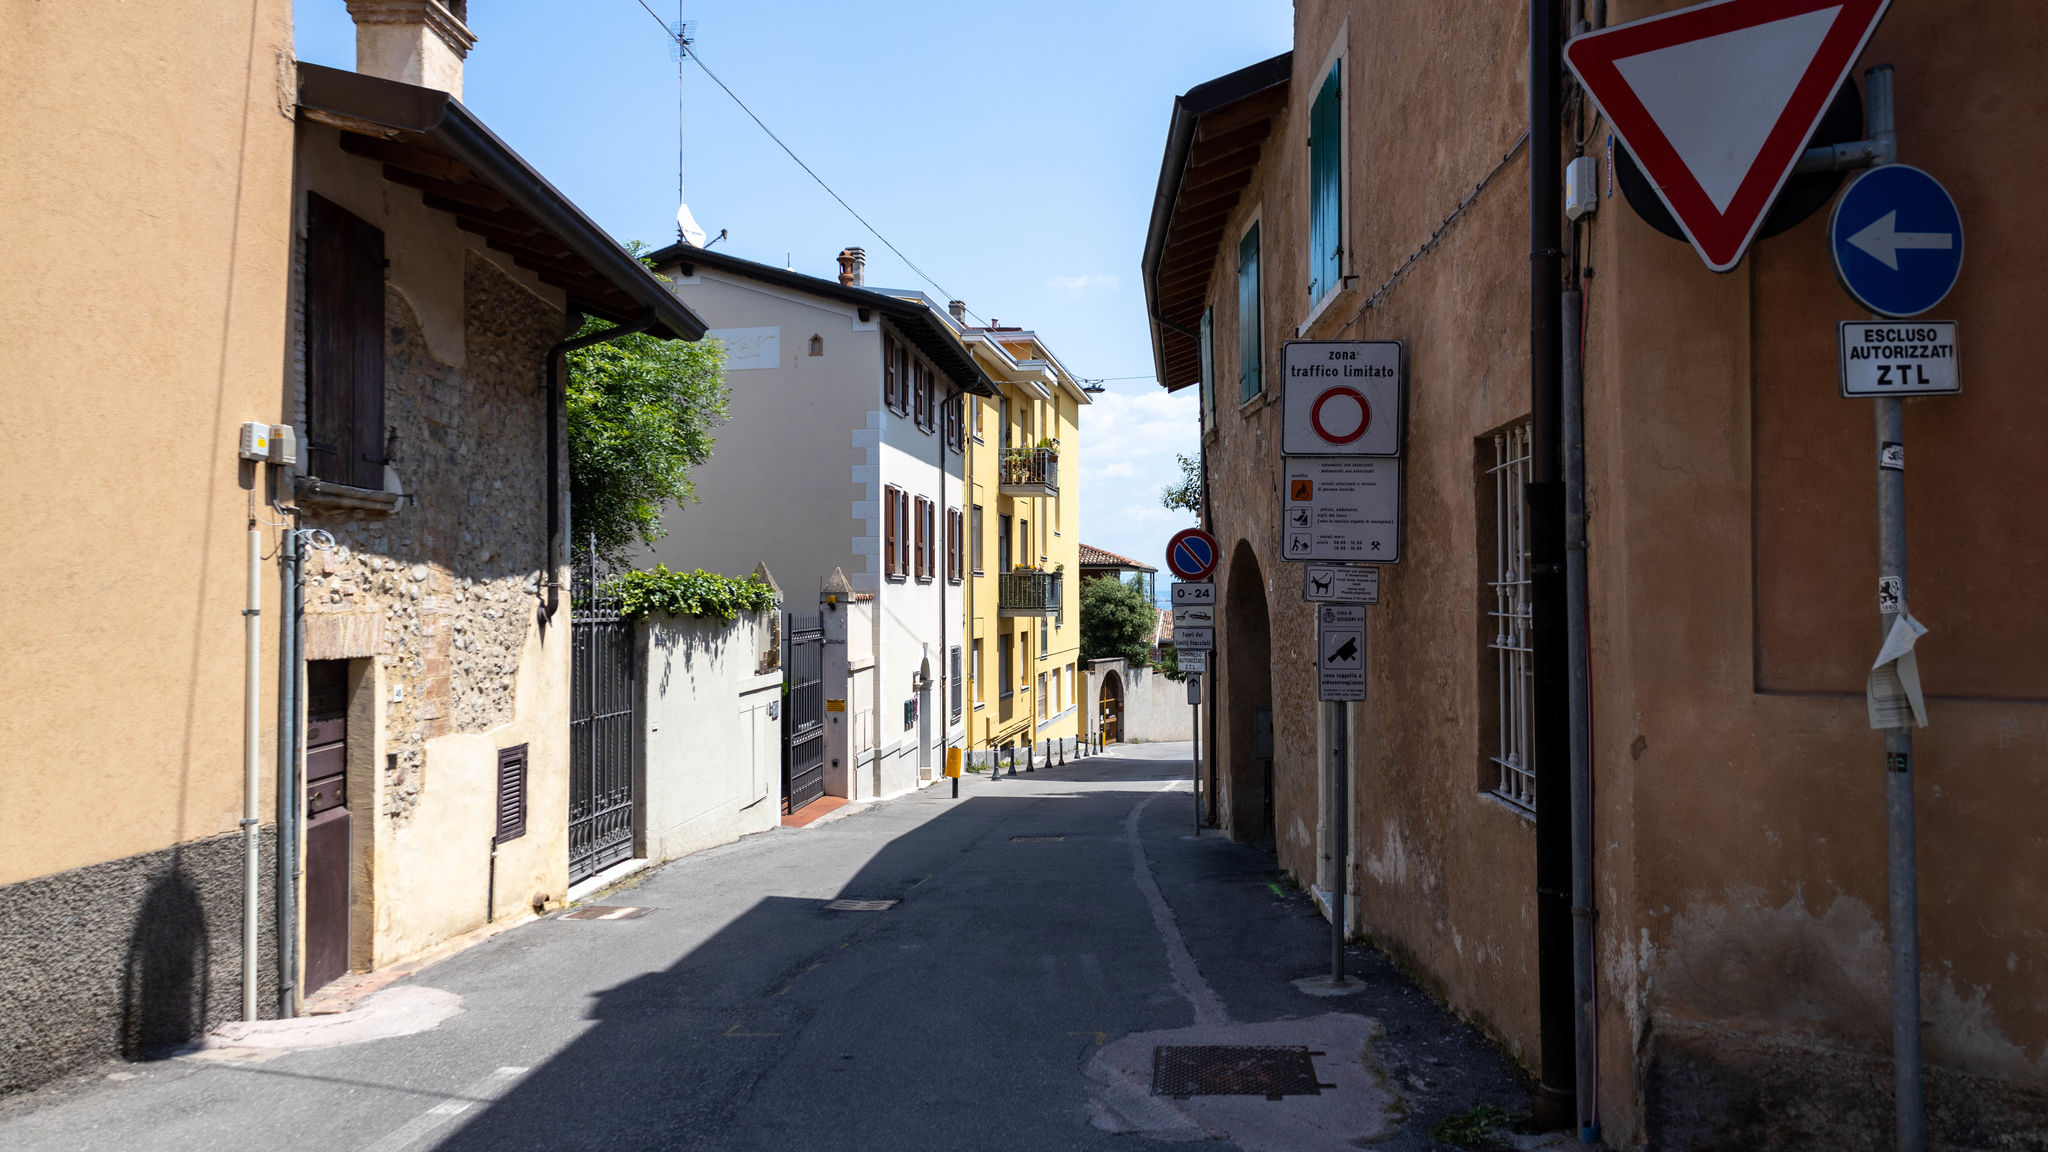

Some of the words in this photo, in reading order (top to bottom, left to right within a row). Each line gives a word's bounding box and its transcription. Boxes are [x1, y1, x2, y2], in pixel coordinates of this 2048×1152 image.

[1864, 328, 1937, 343] ESCLUSO
[1328, 351, 1356, 360] zona
[1849, 344, 1953, 360] AUTORIZZATI
[1291, 365, 1339, 377] traffico
[1343, 365, 1394, 377] limitato
[1195, 589, 1210, 598] 24
